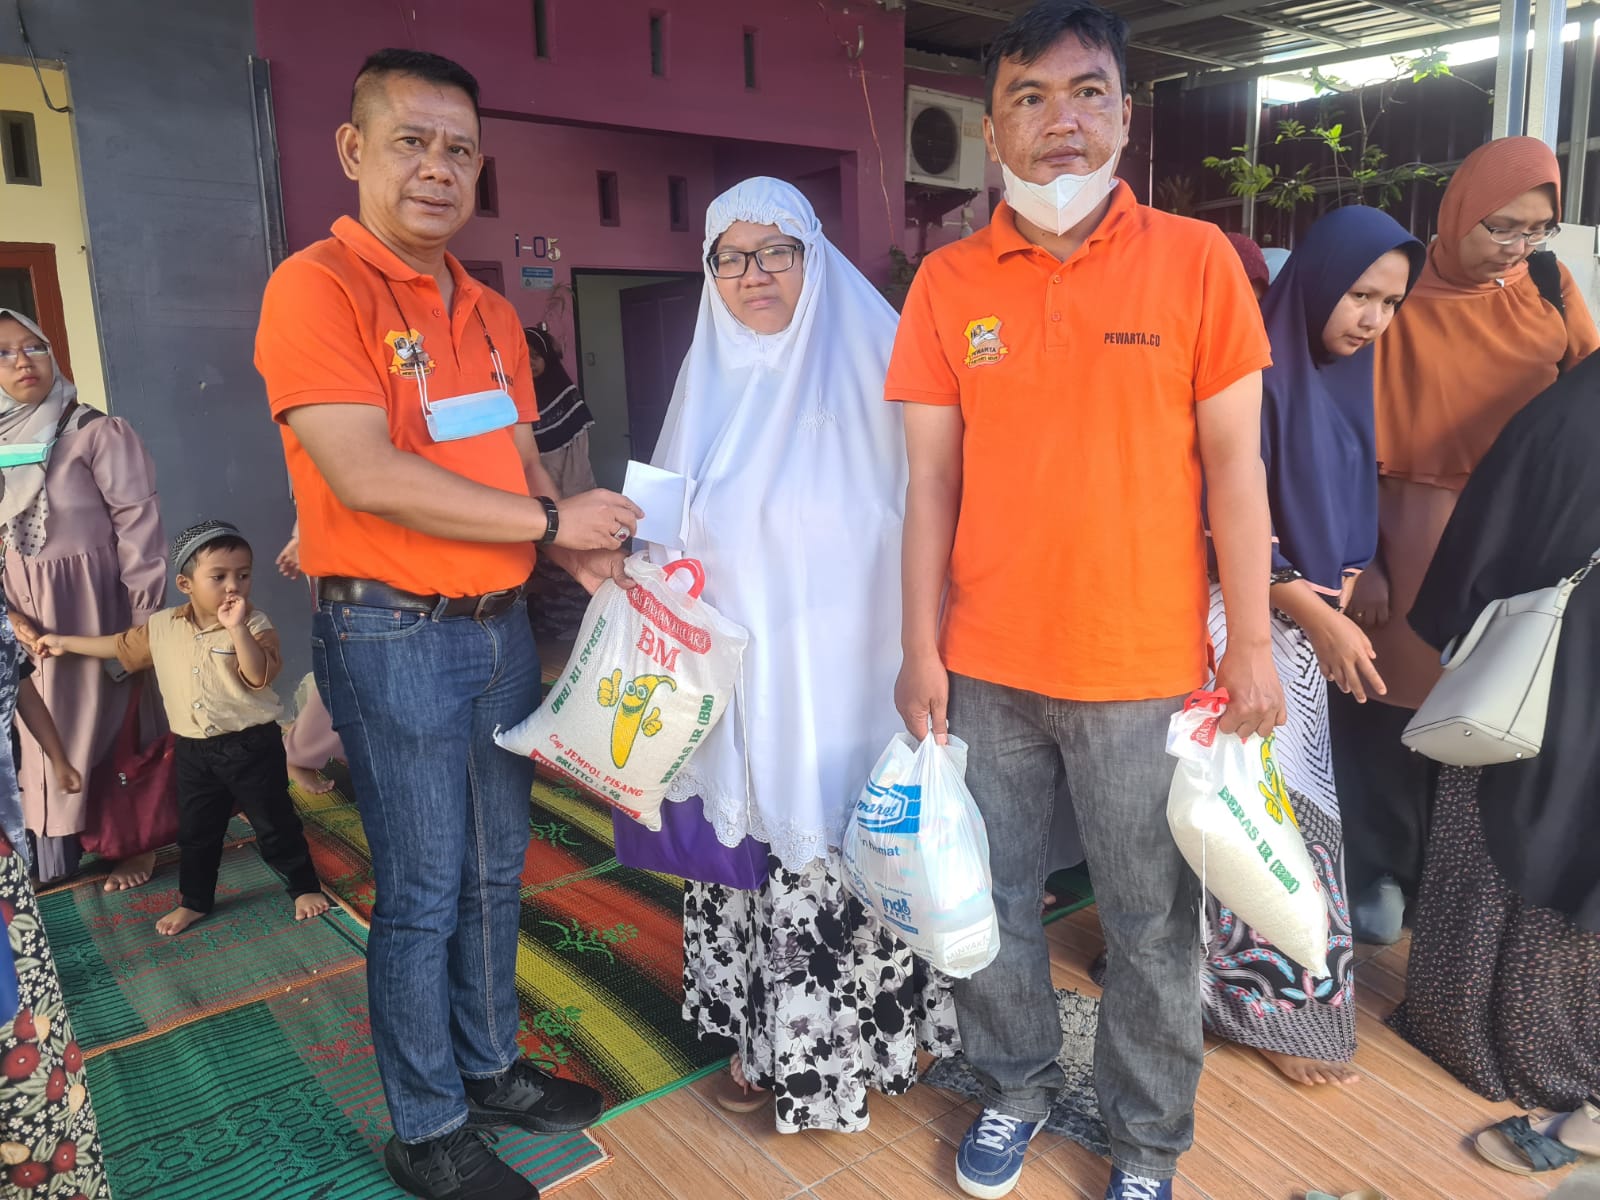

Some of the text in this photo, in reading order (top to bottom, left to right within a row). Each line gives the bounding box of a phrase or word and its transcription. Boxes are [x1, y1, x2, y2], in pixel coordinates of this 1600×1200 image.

[1104, 332, 1160, 347] PEWARTA.CO
[550, 614, 606, 714] BERAS IR (BM)
[636, 623, 681, 673] BM
[688, 729, 705, 743] IR
[697, 694, 715, 725] (BM)
[549, 733, 644, 797] Cap JEMPOL PISANG
[555, 755, 594, 784] BRUTTO
[1218, 785, 1260, 840] BERAS
[1256, 838, 1273, 863] IR
